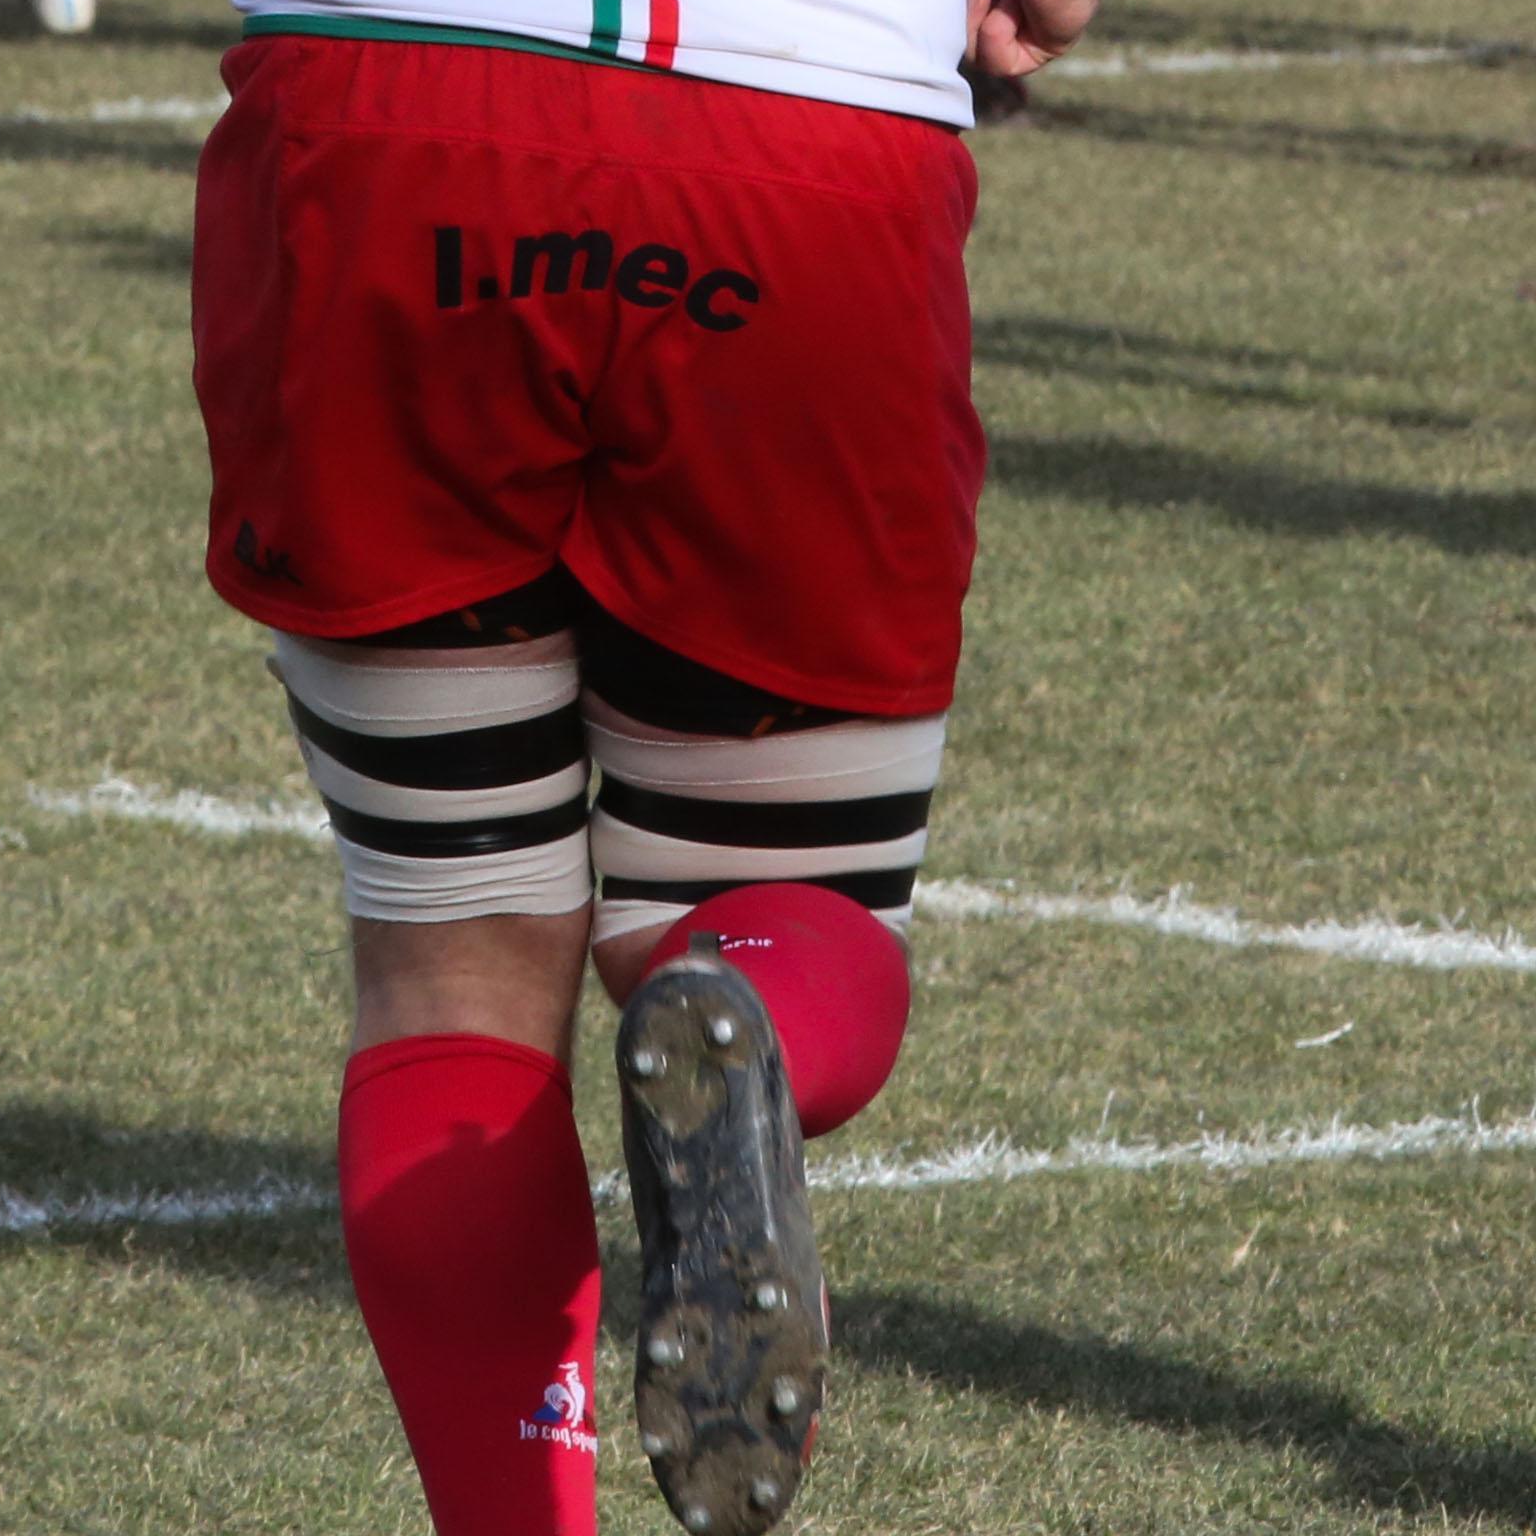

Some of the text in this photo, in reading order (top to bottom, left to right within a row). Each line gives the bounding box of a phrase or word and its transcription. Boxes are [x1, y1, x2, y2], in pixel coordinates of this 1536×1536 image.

[434, 226, 760, 332] I.mec
[519, 1418, 538, 1441] le
[541, 1424, 573, 1451] coq
